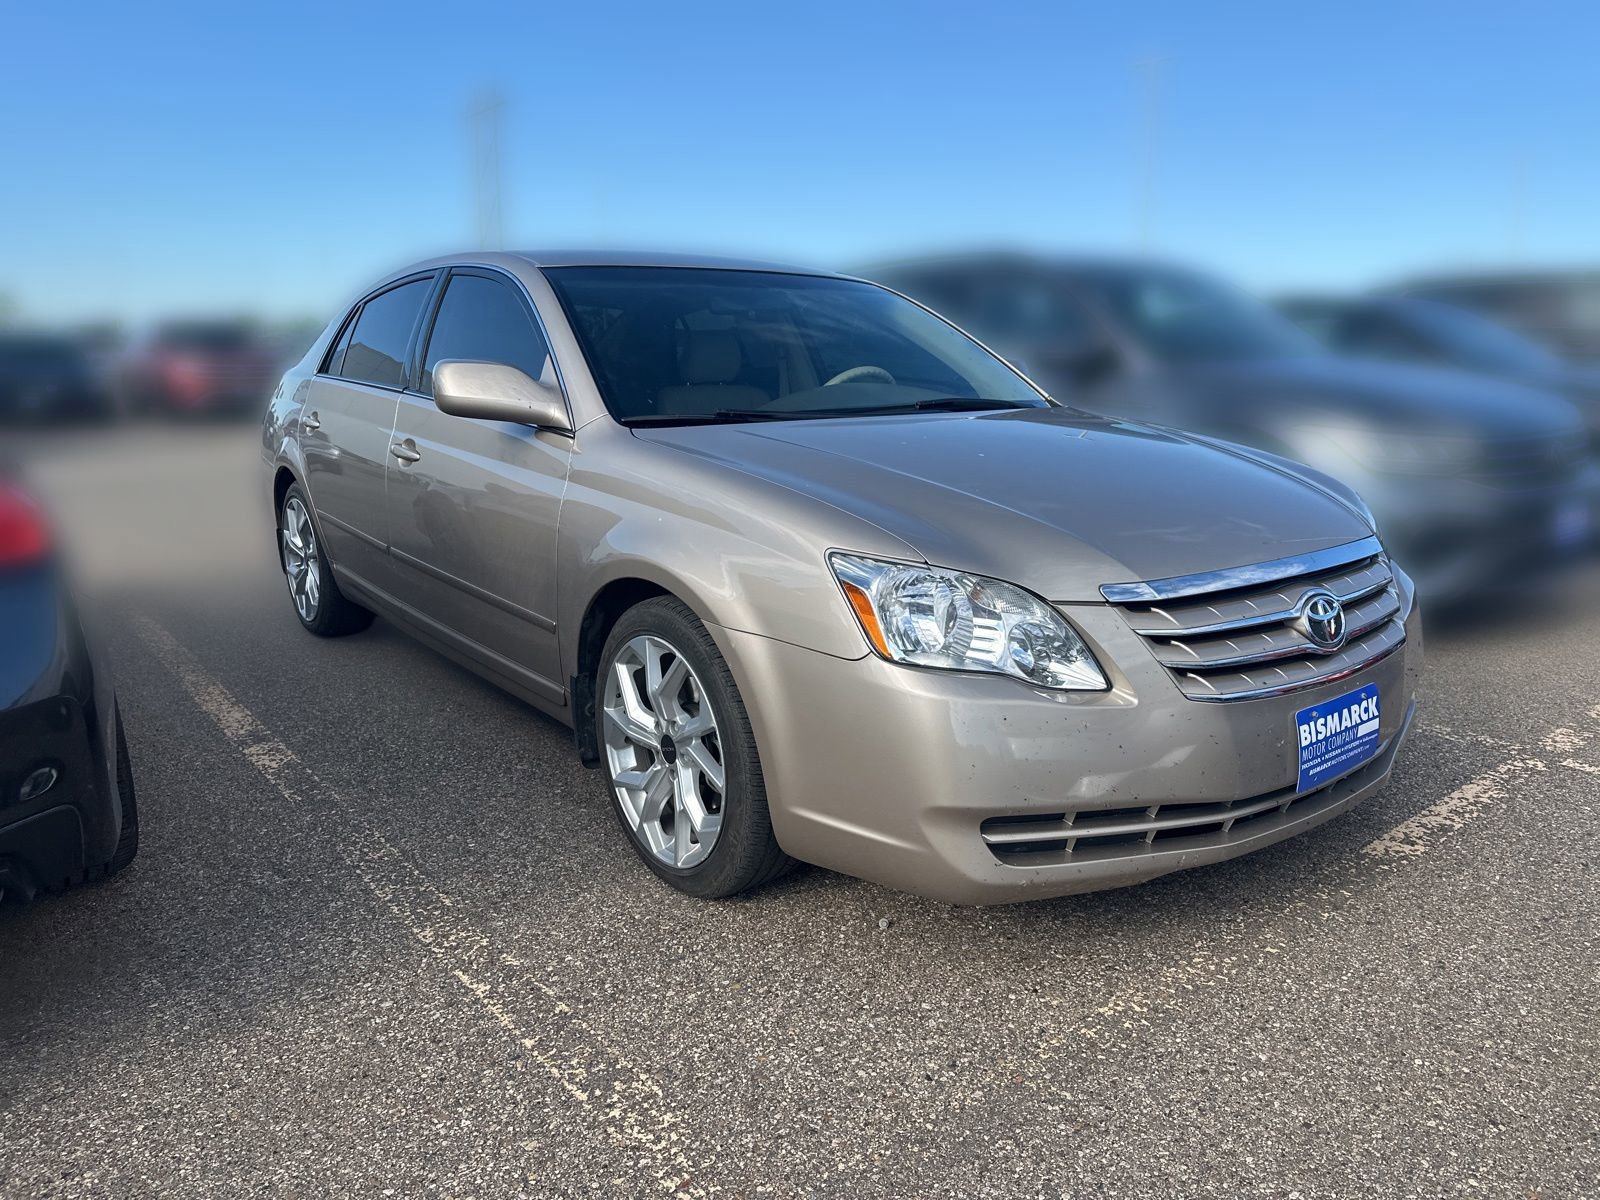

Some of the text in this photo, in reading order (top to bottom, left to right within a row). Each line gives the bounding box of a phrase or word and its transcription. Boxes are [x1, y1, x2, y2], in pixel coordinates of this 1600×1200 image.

[1300, 695, 1379, 747] BISMARCK
[1302, 741, 1326, 762] MOTOR
[1327, 727, 1359, 750] COMPANY
[1302, 757, 1321, 770] HONDA
[1324, 748, 1342, 760] NISSAN
